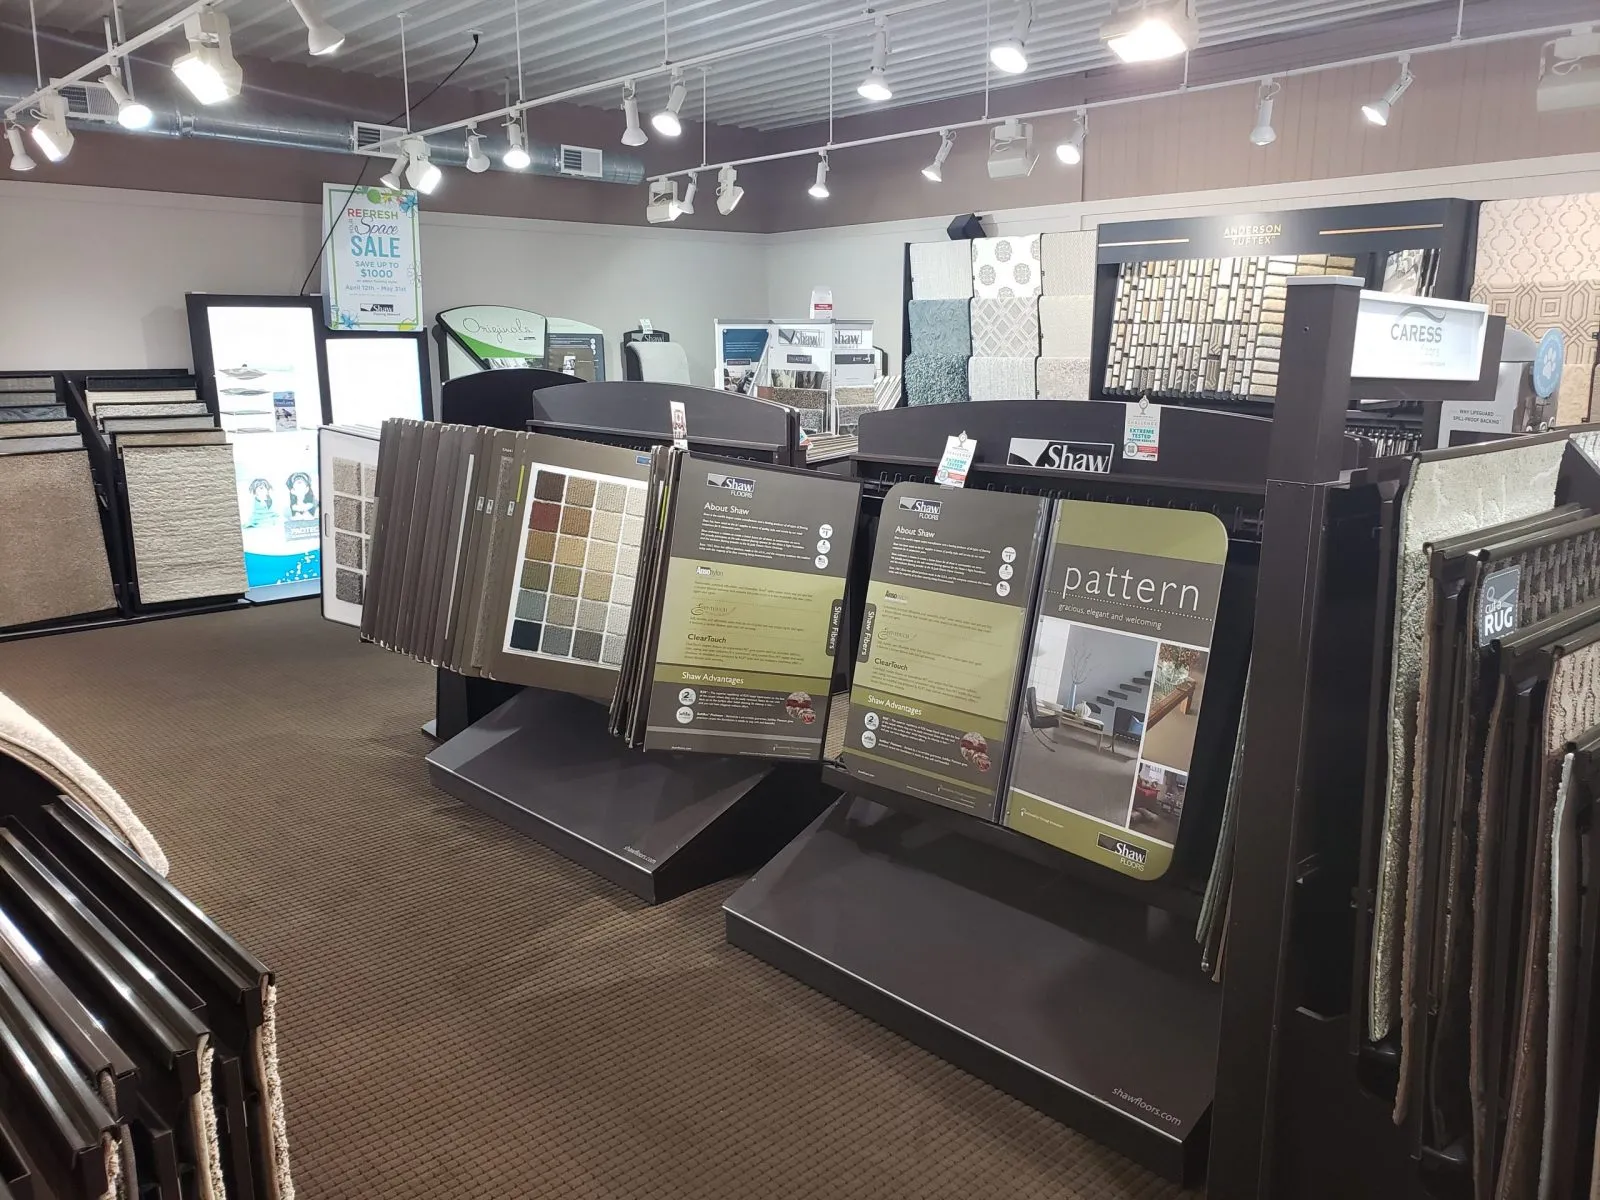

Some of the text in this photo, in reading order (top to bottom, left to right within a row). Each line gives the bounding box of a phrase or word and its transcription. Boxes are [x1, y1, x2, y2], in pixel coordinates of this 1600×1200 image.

[348, 208, 399, 220] REFRESH
[355, 216, 399, 239] Space
[1223, 223, 1282, 236] ANDERSON
[351, 236, 401, 258] SALE
[1231, 236, 1273, 249] TUFTEX
[355, 261, 399, 270] SAVE UP TO
[360, 270, 393, 279] $1000
[373, 304, 394, 312] Shaw
[463, 317, 535, 343] Originals
[1390, 323, 1443, 343] CARESS
[1044, 443, 1109, 473] Shaw
[724, 478, 755, 493] Shaw
[730, 490, 753, 499] FLOORS
[703, 502, 750, 516] About Shaw
[914, 501, 940, 514] Shaw
[919, 512, 939, 521] FLOORS
[895, 526, 936, 539] About Shaw
[1062, 565, 1200, 611] pattern
[1485, 600, 1496, 614] cut
[1058, 602, 1163, 631] gracious, elegant and welcoming
[1484, 606, 1513, 637] RUG
[829, 606, 843, 650] Shaw Fibers
[861, 611, 876, 656] Shaw Fibers
[687, 633, 727, 644] ClearTouch
[874, 657, 908, 672] ClearTouch
[682, 672, 745, 687] Shaw Advantages
[867, 694, 923, 716] Shaw Advantages
[1114, 841, 1147, 863] Shaw
[1119, 857, 1146, 872] FLOORS
[1112, 1087, 1181, 1126] shawfloors.com
